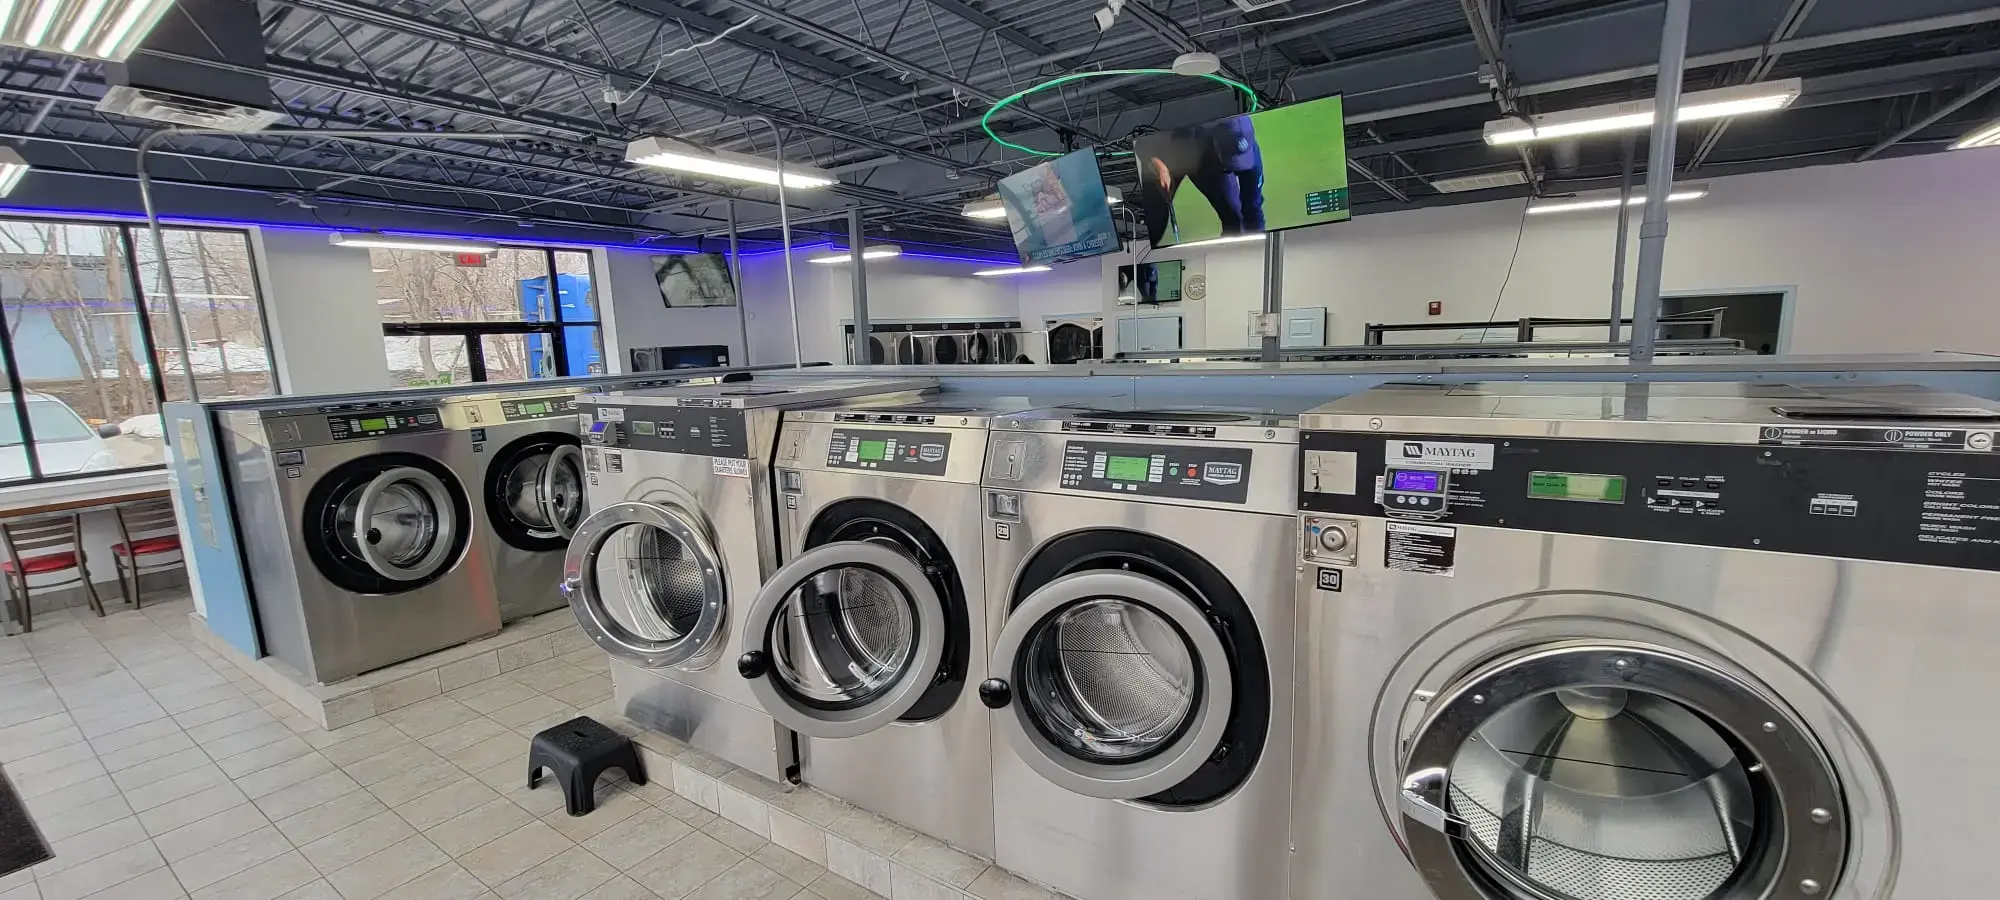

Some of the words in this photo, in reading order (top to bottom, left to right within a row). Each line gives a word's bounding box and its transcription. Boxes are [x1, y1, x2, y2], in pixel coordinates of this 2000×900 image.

[1425, 447, 1476, 458] MAYTAG
[1208, 466, 1238, 475] MAYTAG
[1322, 573, 1337, 585] 30
